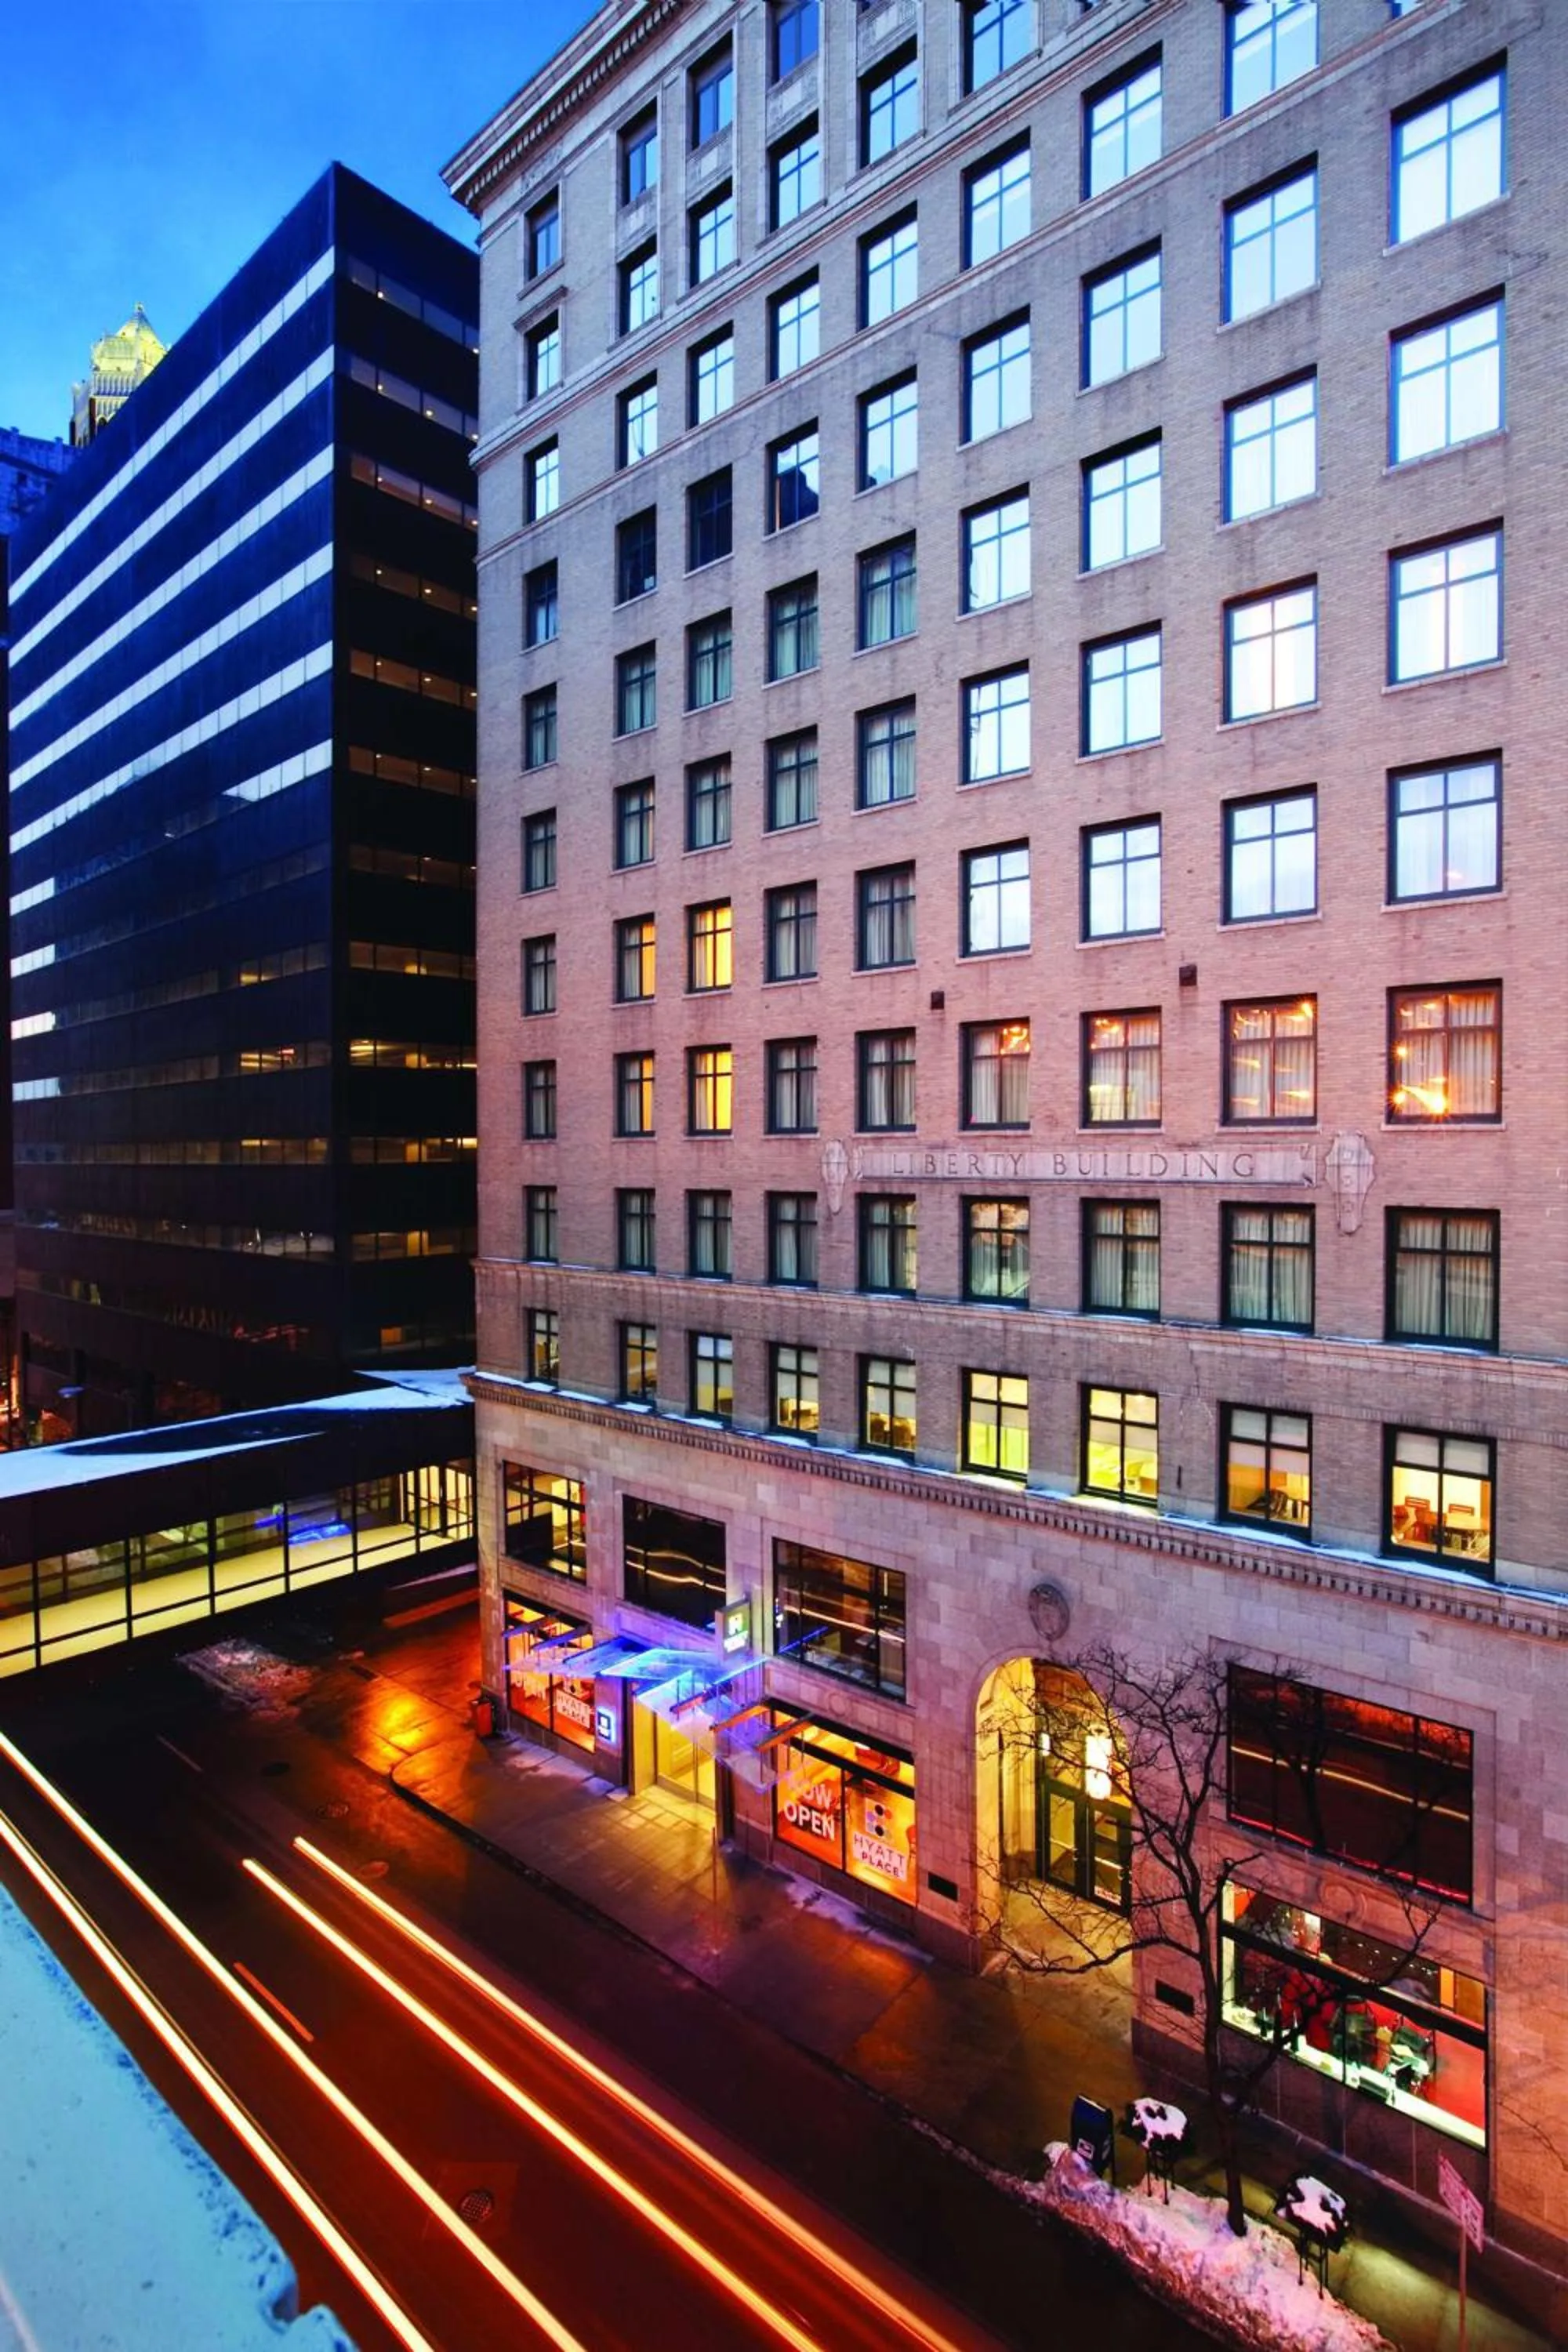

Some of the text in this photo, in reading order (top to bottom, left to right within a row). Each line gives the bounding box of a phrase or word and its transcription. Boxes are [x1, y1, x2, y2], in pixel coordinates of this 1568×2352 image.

[892, 1153, 1254, 1178] LIBERTY BUILDING
[784, 1800, 835, 1842] OPEN
[853, 1834, 905, 1867] HYATT
[862, 1850, 900, 1878] PLACE
